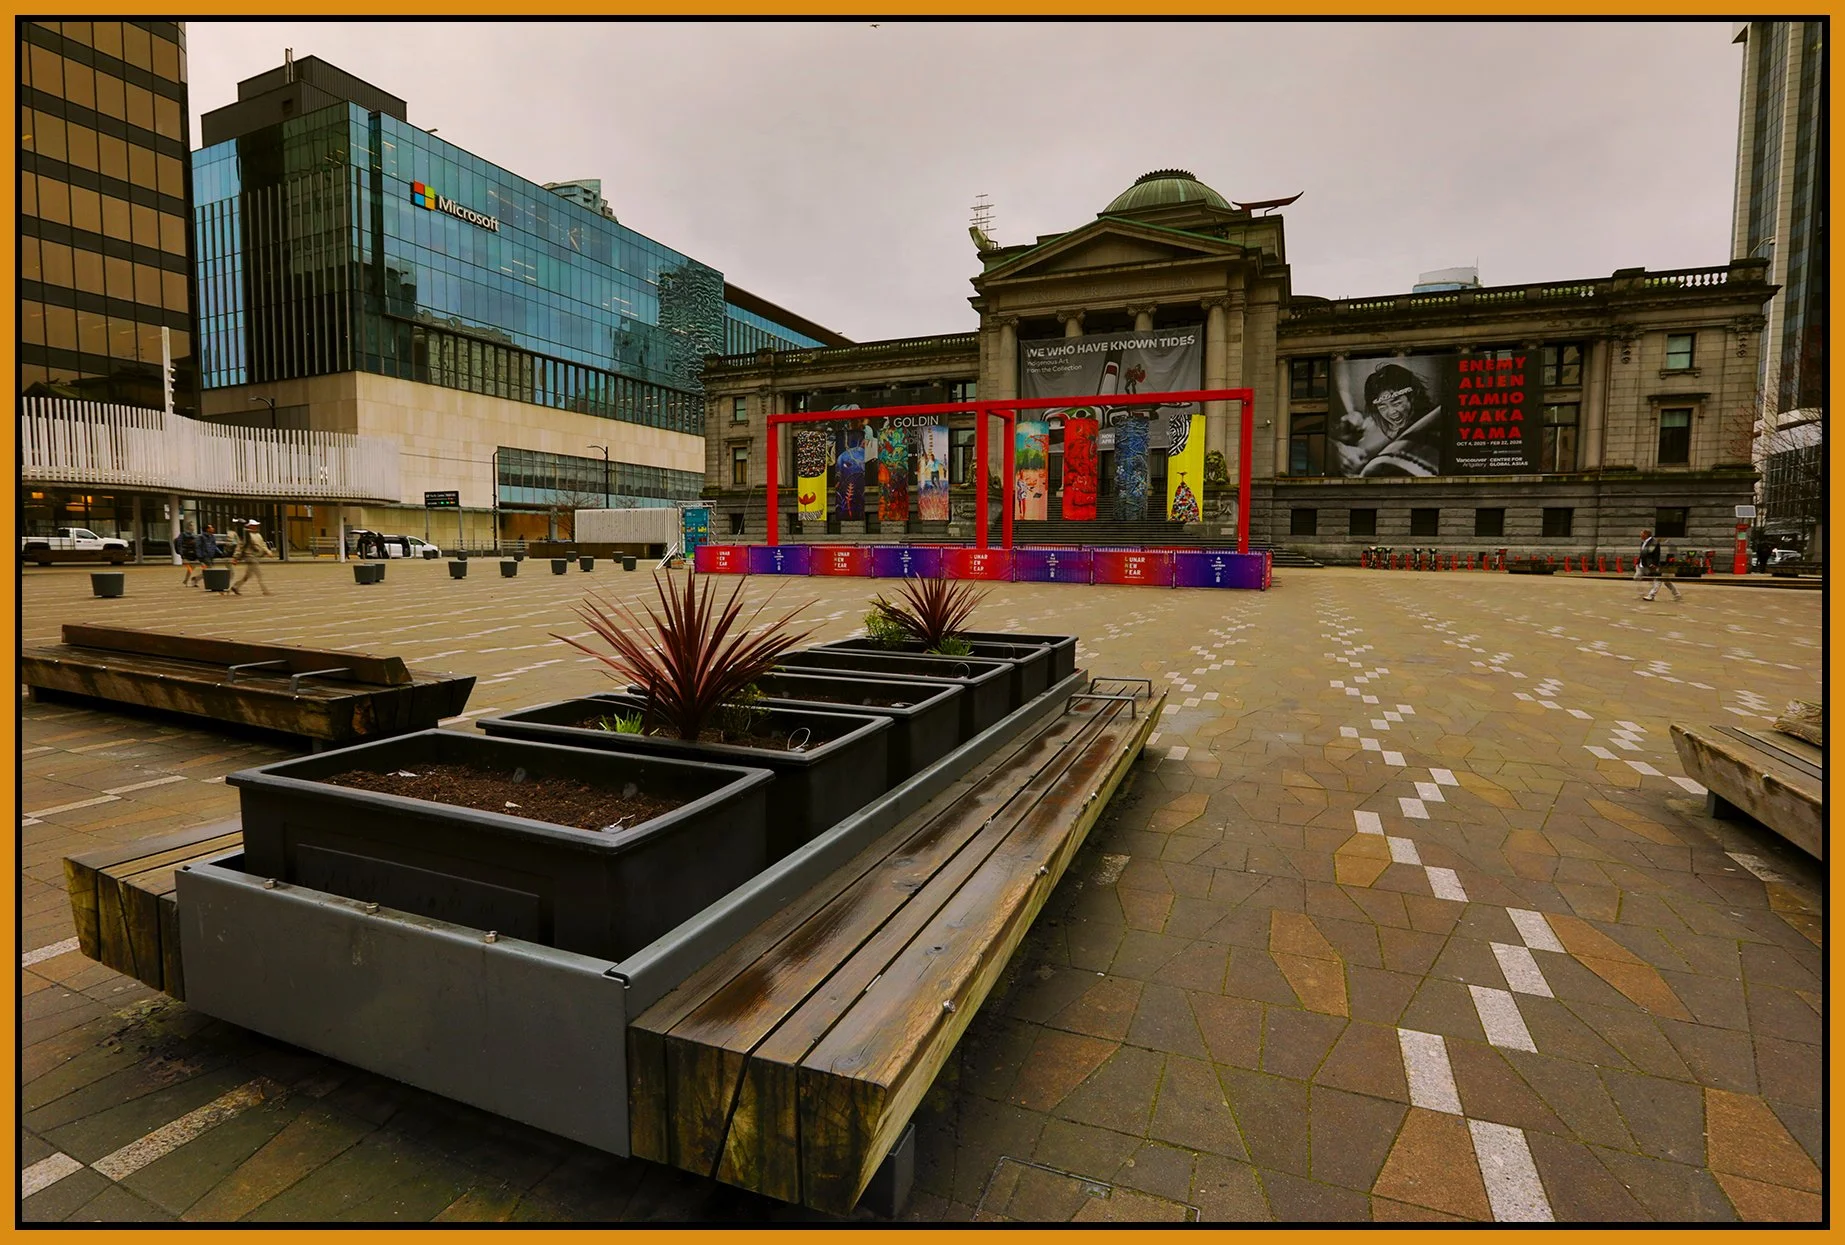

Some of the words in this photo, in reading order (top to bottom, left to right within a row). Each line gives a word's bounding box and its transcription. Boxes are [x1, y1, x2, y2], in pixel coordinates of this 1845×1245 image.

[438, 195, 499, 232] Microsoft
[1026, 348, 1045, 358] WE
[1046, 345, 1075, 356] WHO
[1077, 342, 1108, 354] HAVE
[1110, 338, 1157, 351] KNOWN
[1159, 335, 1195, 347] TIDES
[1026, 359, 1058, 368] ndigenous
[1052, 364, 1083, 372] Collection
[1458, 356, 1527, 373] ENEMY
[1459, 374, 1525, 389] ALIEN
[1458, 391, 1525, 406] TAMIO
[893, 415, 939, 428] GOLDIN
[1458, 408, 1524, 423] WAKA
[1458, 426, 1522, 440] YAMA
